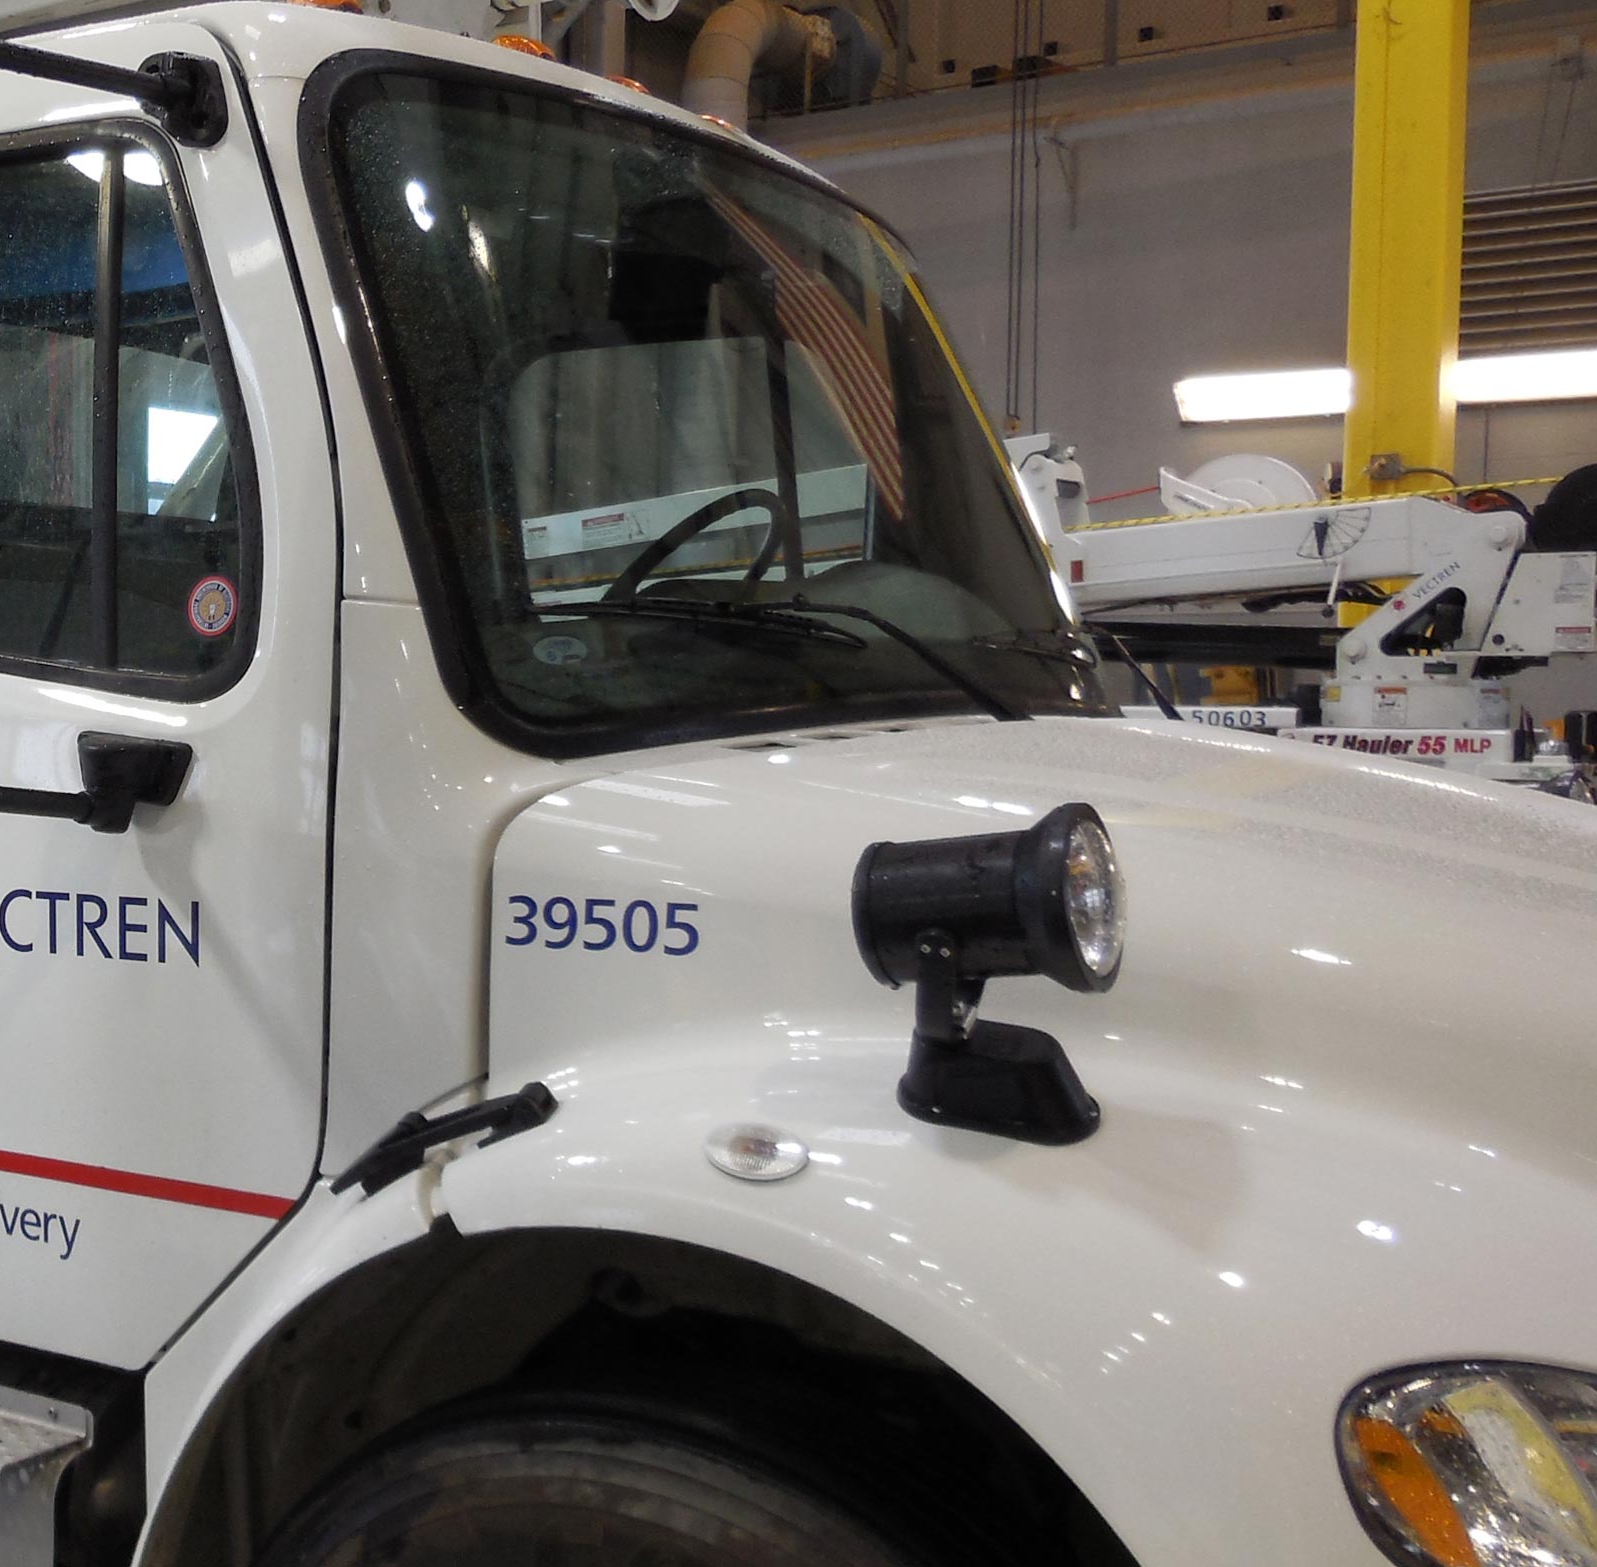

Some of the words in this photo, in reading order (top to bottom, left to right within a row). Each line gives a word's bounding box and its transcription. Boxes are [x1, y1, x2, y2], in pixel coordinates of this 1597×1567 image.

[1412, 561, 1461, 600] VECTREN
[1191, 709, 1267, 728] 50603
[1342, 734, 1413, 755] Hauler
[1417, 735, 1447, 755] 55
[1454, 737, 1493, 753] MLP
[505, 895, 699, 956] 39505
